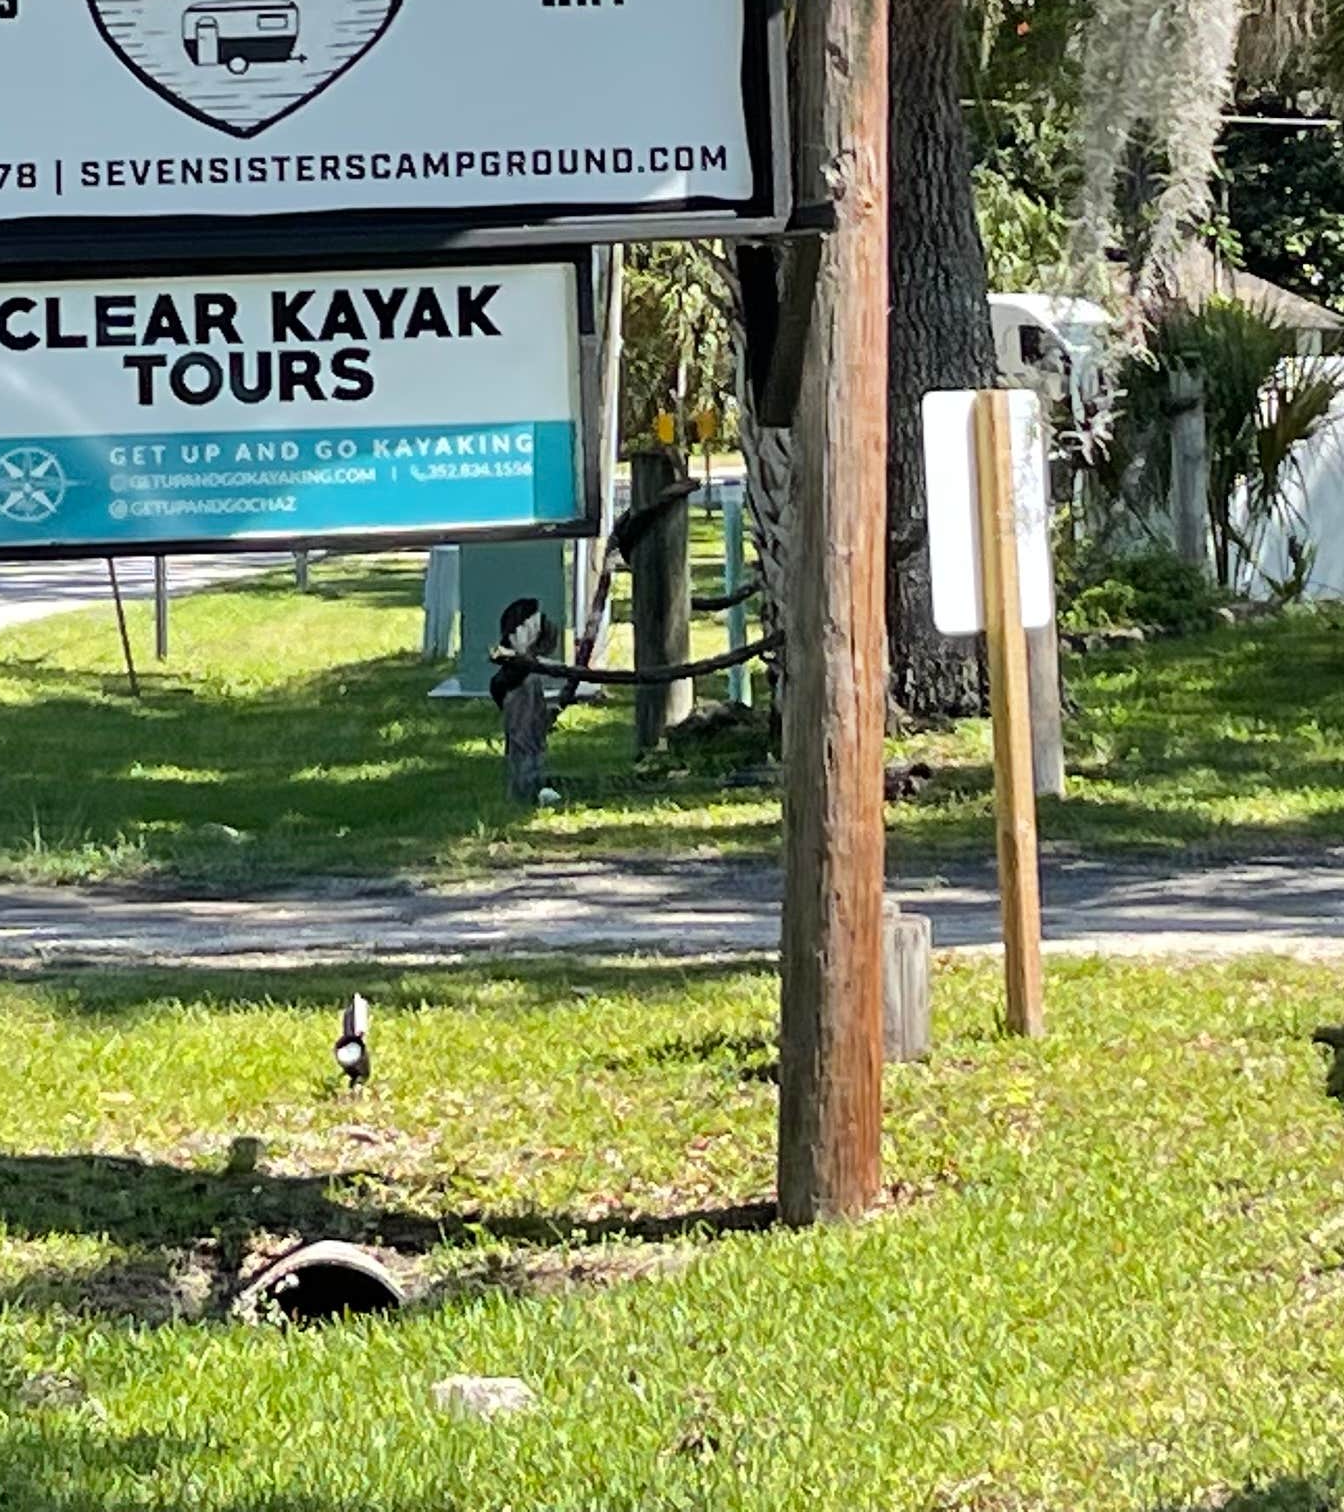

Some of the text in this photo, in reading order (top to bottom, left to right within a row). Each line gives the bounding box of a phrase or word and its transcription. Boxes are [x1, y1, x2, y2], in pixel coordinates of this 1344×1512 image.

[80, 144, 729, 189] SEVENSISTERSCAMPGROUND.COM
[271, 285, 501, 343] KAYAK
[123, 347, 375, 406] TOURS
[109, 433, 534, 466] GET UP AND GO KAYAKING
